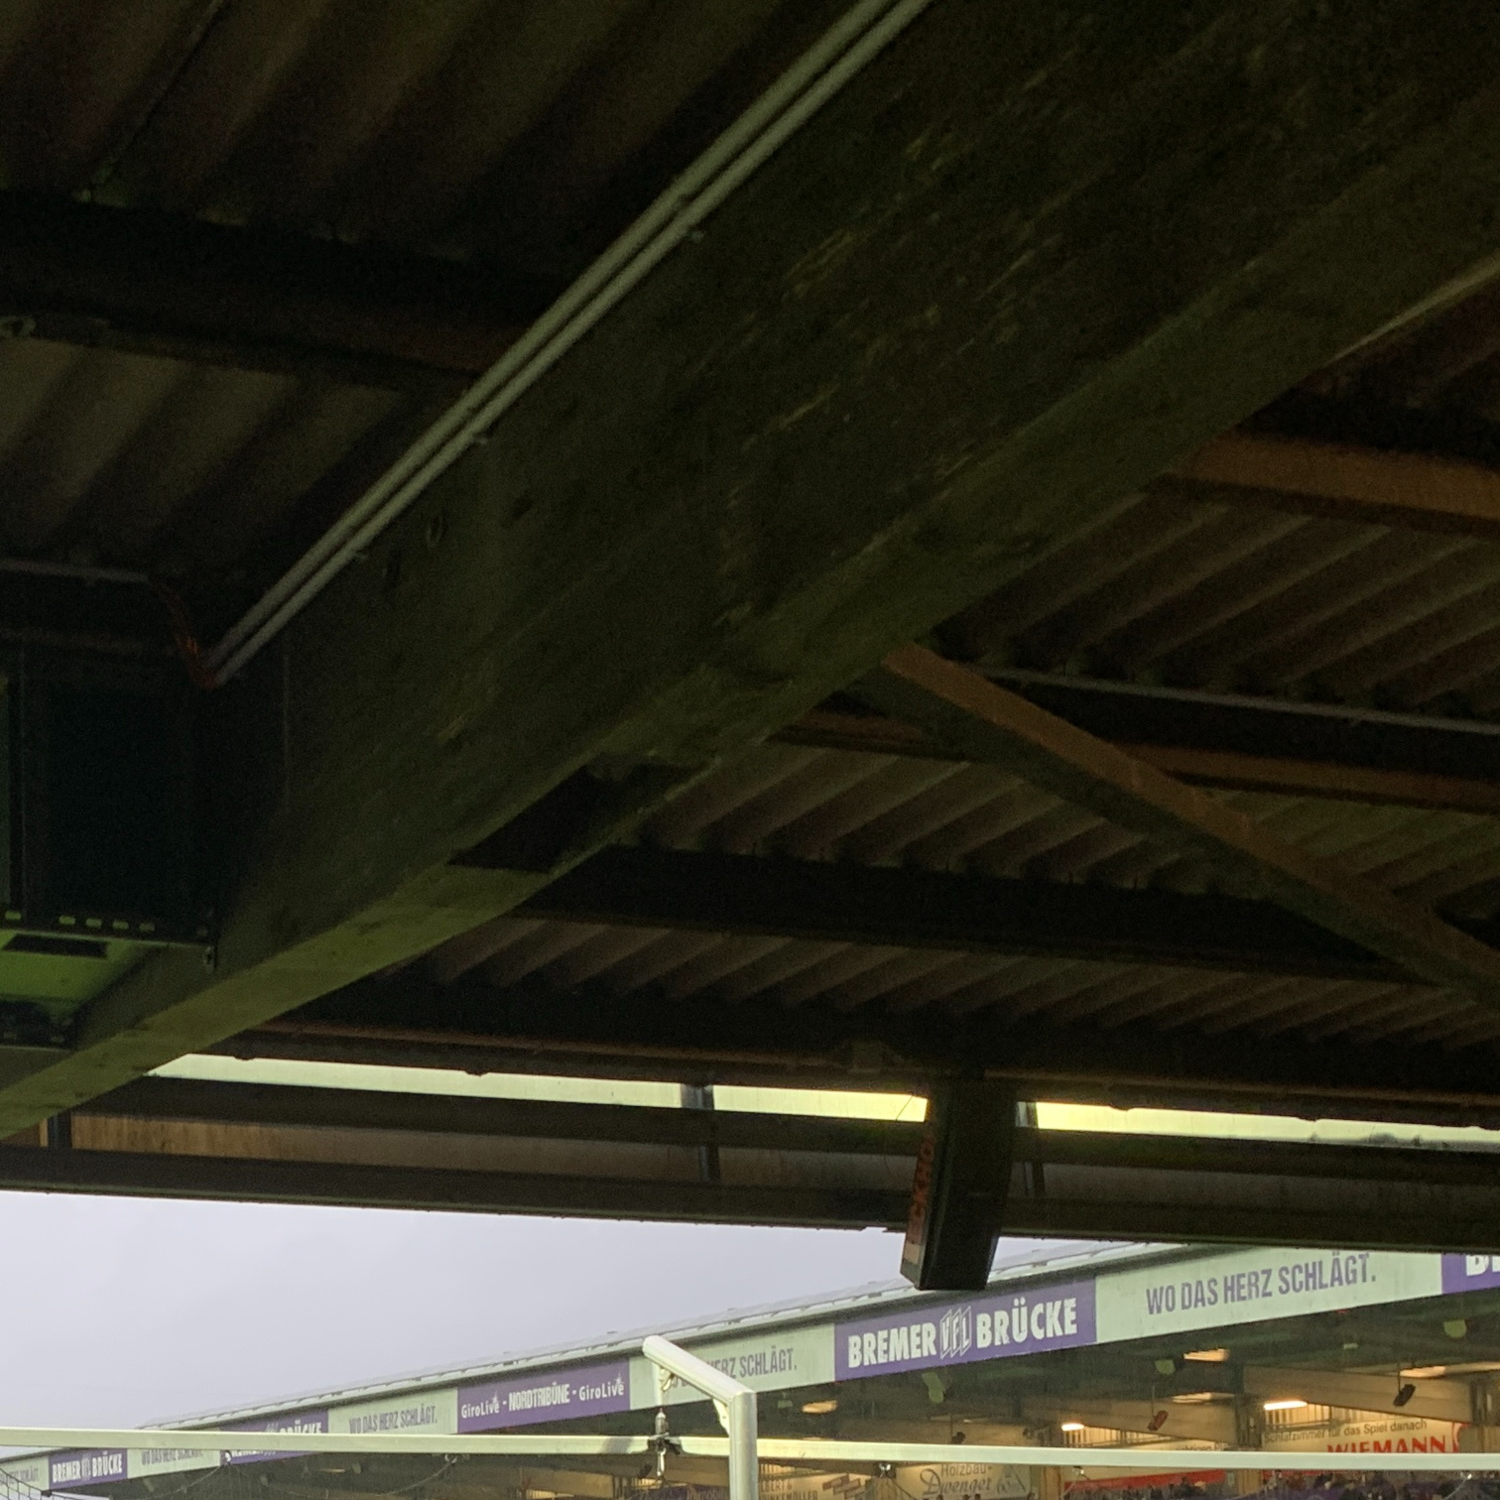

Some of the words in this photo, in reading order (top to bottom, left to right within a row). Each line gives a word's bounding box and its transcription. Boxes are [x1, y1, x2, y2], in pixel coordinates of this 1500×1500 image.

[1146, 1287, 1175, 1315] WO
[1181, 1279, 1218, 1311] DAS
[1223, 1269, 1272, 1303] HERZ
[1278, 1252, 1376, 1297] SCHLÄGT.
[847, 1326, 936, 1369] BREMER
[976, 1298, 1078, 1347] BRÜCKE
[461, 1396, 500, 1419] GiroLive
[508, 1383, 570, 1412] NORDTRIBÜNE
[579, 1378, 625, 1400] GiroLive
[363, 1415, 378, 1432] DAS
[379, 1411, 399, 1430] HERZ
[1344, 1424, 1361, 1436] das
[1363, 1422, 1388, 1437] Spiel
[92, 1451, 123, 1477] BRÜCKE
